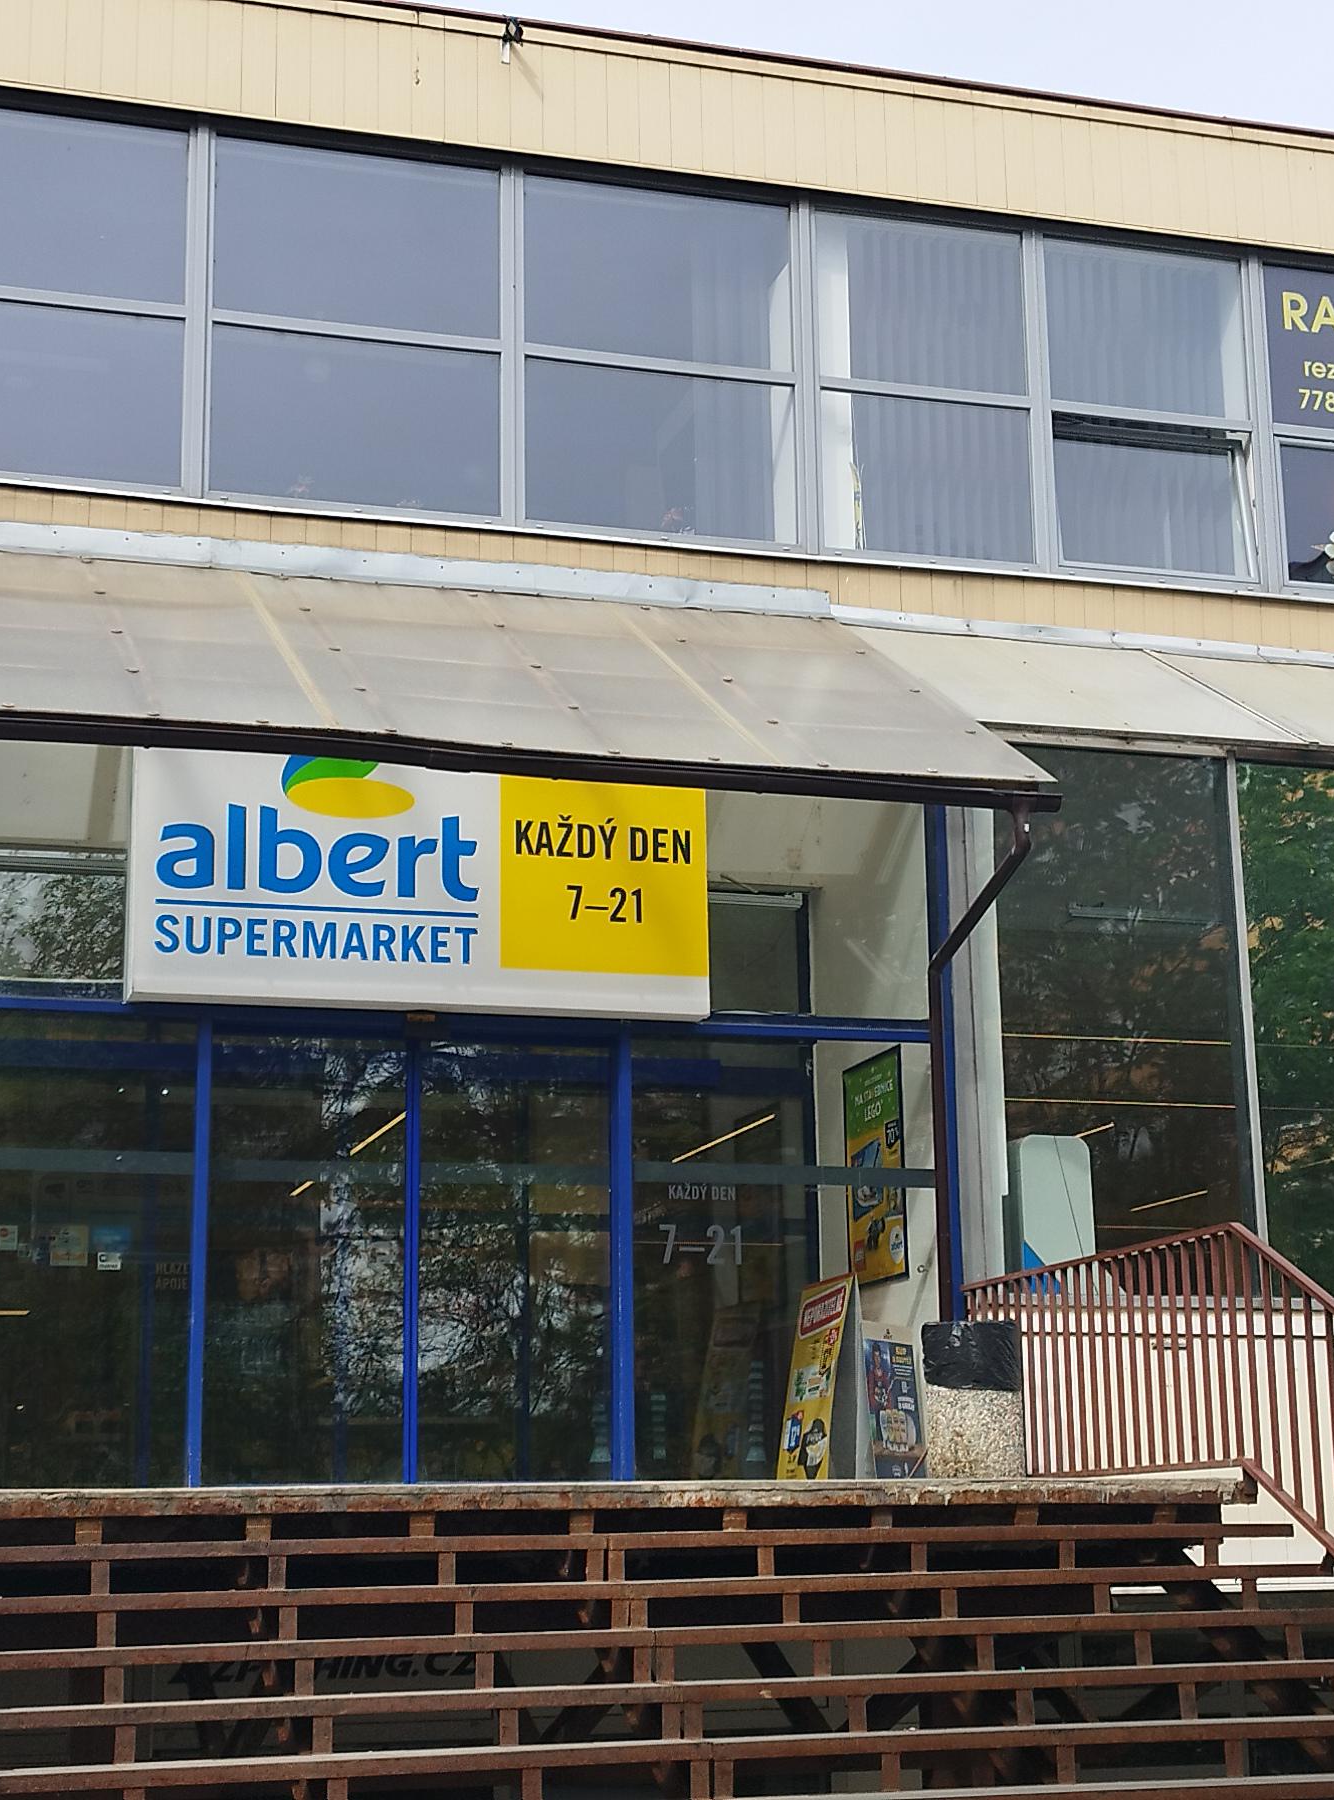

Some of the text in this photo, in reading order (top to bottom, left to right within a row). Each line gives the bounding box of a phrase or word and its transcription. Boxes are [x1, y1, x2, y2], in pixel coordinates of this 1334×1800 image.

[155, 802, 479, 902] albert
[514, 813, 692, 865] KAŽDÝ DEN
[154, 914, 479, 965] SUPERMARKET
[668, 1181, 736, 1200] KAŽDÝ DEN
